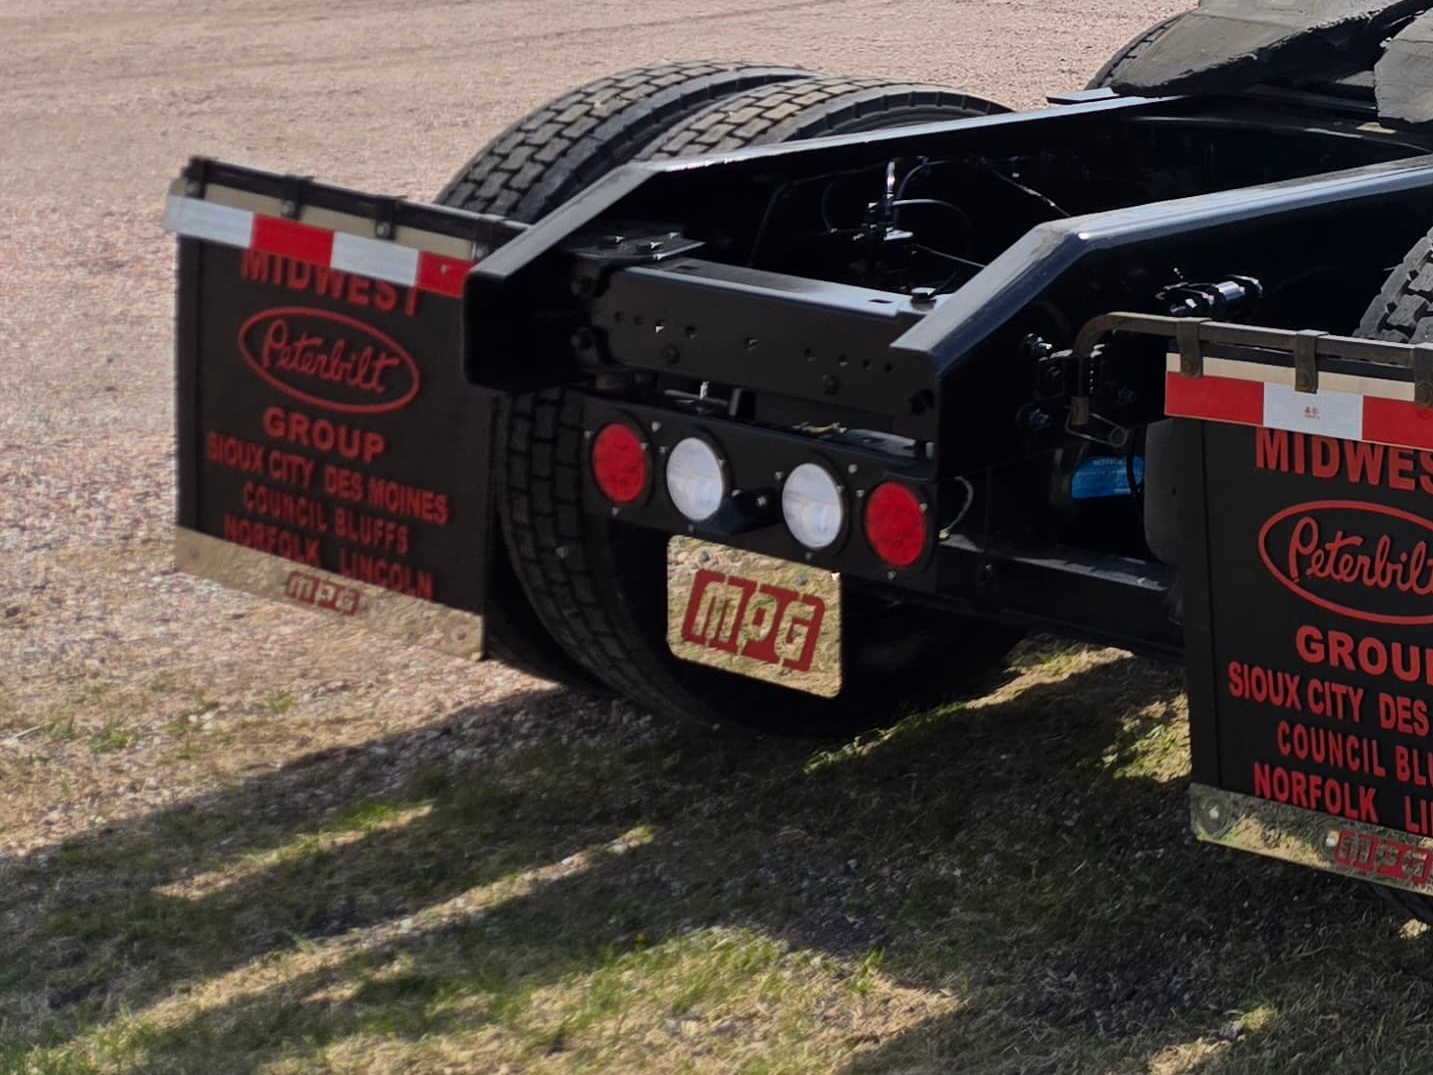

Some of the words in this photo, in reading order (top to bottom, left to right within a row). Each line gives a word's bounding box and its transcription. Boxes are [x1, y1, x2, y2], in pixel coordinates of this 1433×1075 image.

[241, 252, 418, 317] MIDWEST
[262, 320, 402, 395] Peterbilt
[263, 407, 386, 464] GROUP
[207, 433, 266, 473] SIOUX
[268, 451, 317, 487] CITY
[324, 465, 365, 504] DES
[367, 479, 450, 525] MOINES
[242, 482, 328, 535] COUNCIL
[335, 508, 410, 556] BLUFFS
[224, 515, 322, 565] NORFOLK
[338, 550, 434, 603] LINCOLN
[690, 578, 818, 663] MPG
[1227, 661, 1301, 710] SIOUX
[1306, 678, 1364, 724] CITY
[1378, 692, 1430, 739] DES
[1276, 720, 1387, 780] COUNCIL
[1252, 762, 1380, 826] NORFOLK
